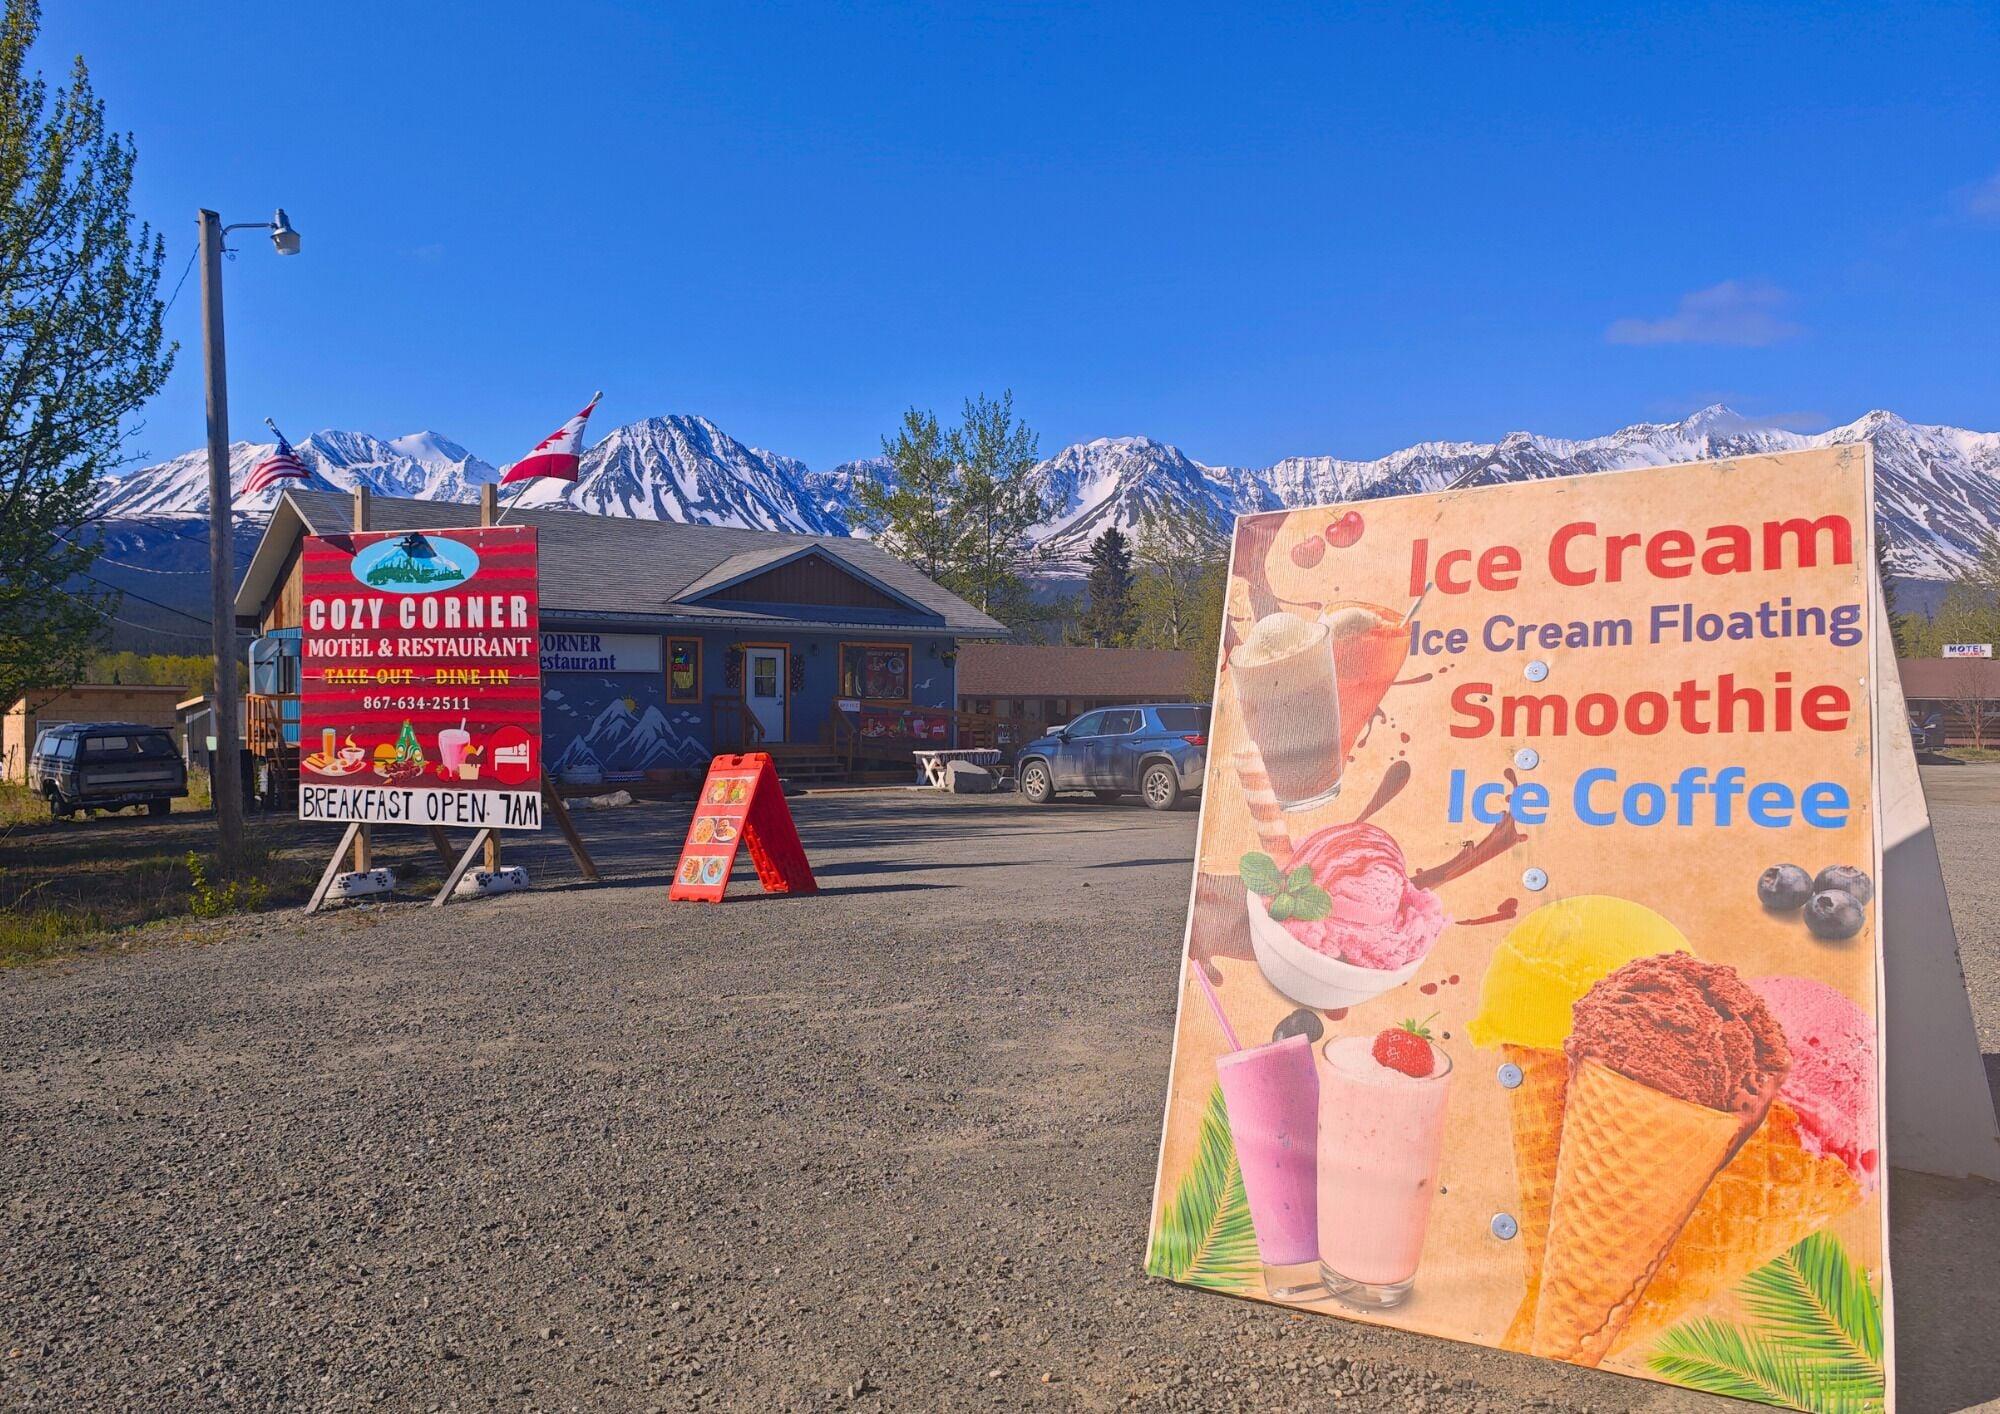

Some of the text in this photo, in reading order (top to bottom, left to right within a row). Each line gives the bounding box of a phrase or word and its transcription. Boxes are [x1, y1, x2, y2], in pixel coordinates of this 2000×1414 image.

[1409, 514, 1853, 597] Ice Cream
[310, 596, 528, 630] COZY CORNER
[1409, 598, 1861, 655] Ice Cream Floating
[308, 638, 531, 657] MOTEL & RESTAURANT
[540, 653, 616, 670] estaurant
[1949, 645, 1985, 653] MOTEL
[326, 668, 509, 684] TAKE OUT DINE IN
[364, 696, 470, 710] 867-634-2511
[1450, 671, 1851, 738] Smoothie
[303, 787, 539, 826] BREAKFAST OPEN 7AM
[1448, 767, 1850, 829] Ice Coffee
